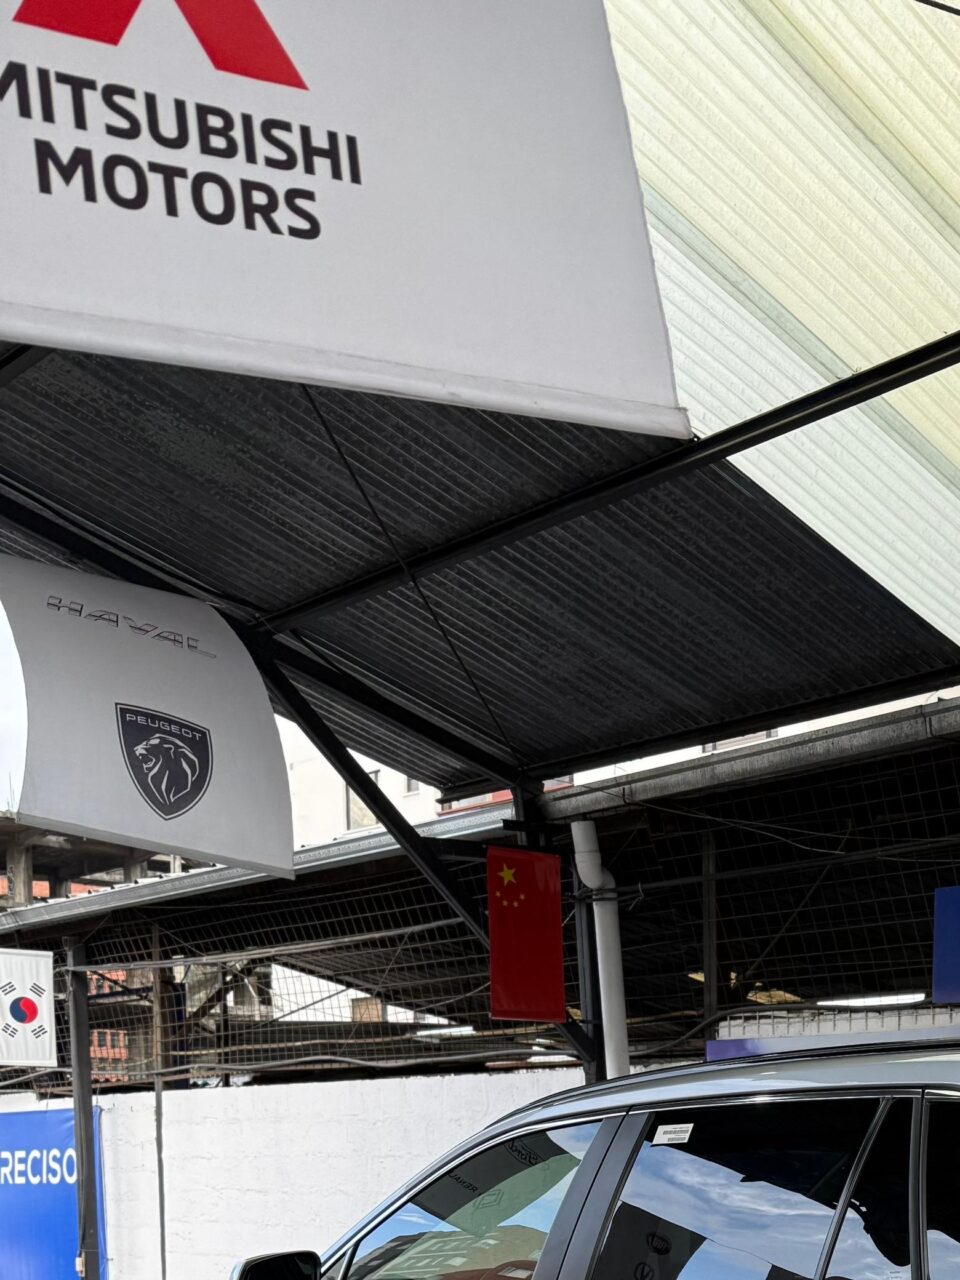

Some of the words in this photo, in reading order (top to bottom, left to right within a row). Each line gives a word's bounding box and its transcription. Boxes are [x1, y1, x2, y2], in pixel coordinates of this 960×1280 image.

[33, 138, 322, 240] MOTORS
[126, 713, 202, 741] PEUGEOT
[0, 1147, 78, 1185] RECISO
